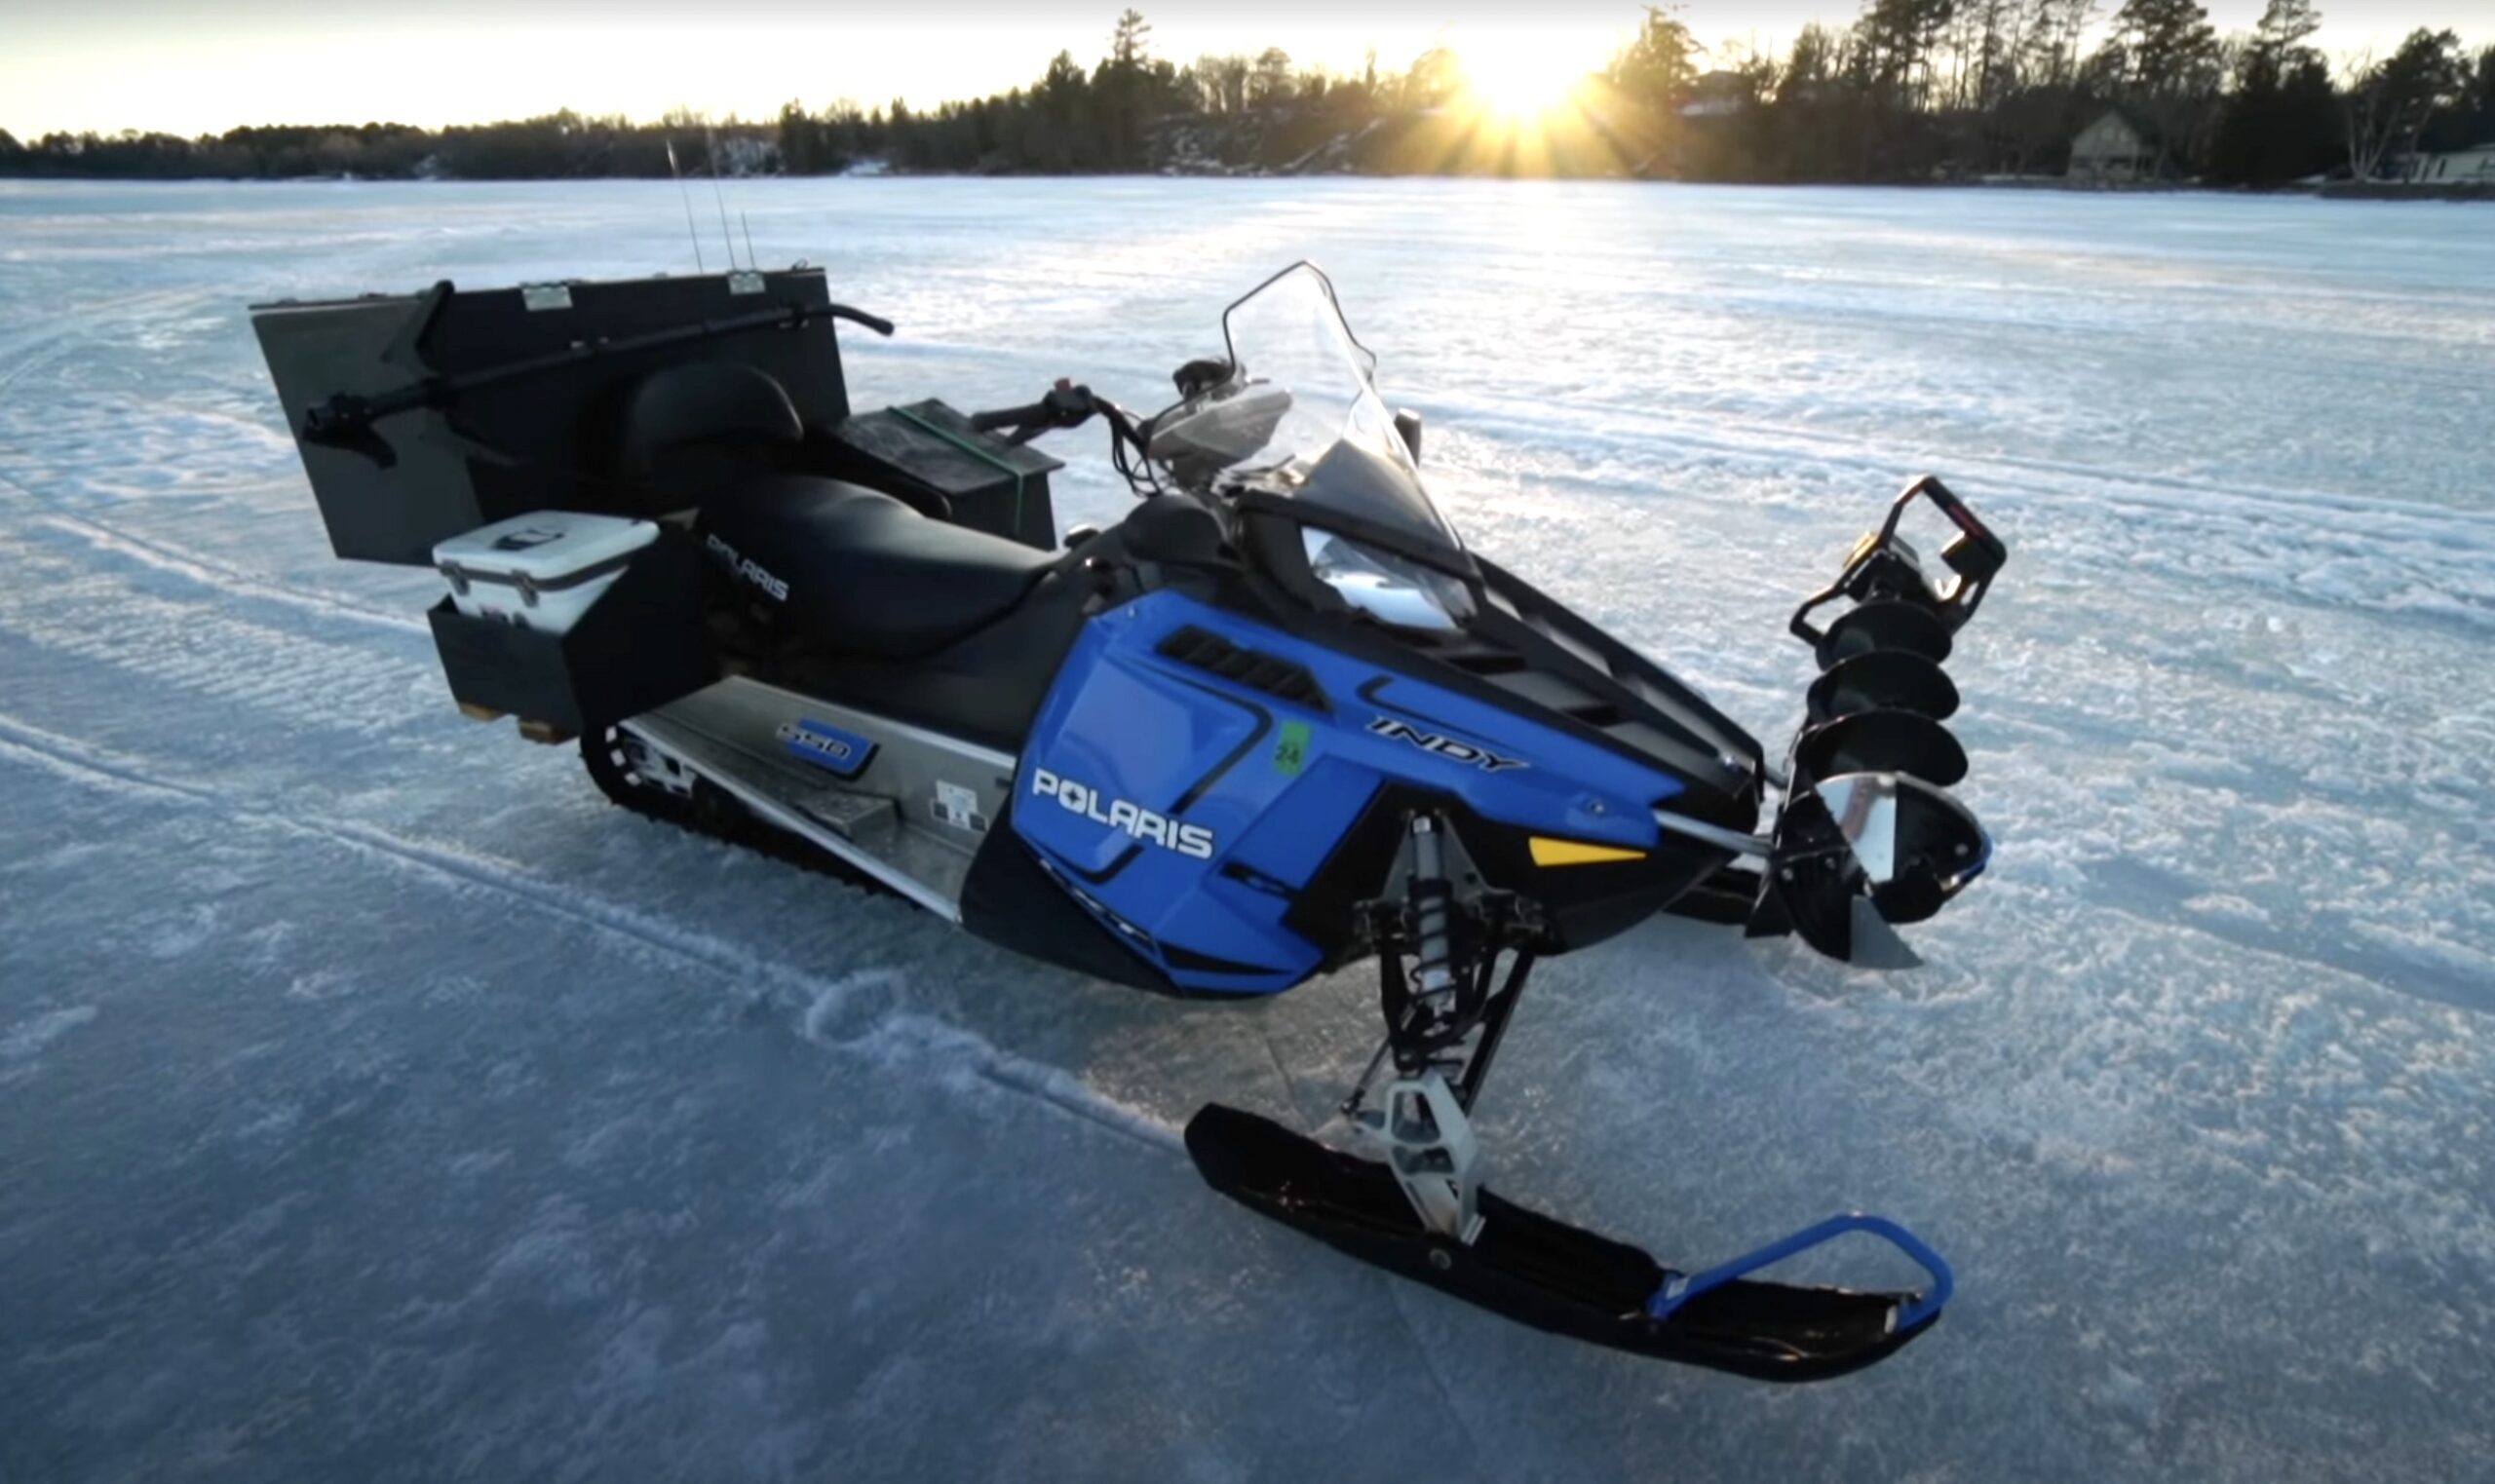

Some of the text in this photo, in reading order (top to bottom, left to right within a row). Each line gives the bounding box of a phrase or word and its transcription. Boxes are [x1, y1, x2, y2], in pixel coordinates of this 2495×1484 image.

[707, 533, 789, 602] POLARIS
[1366, 715, 1530, 773] INDY
[1031, 767, 1214, 860] POLARIS
